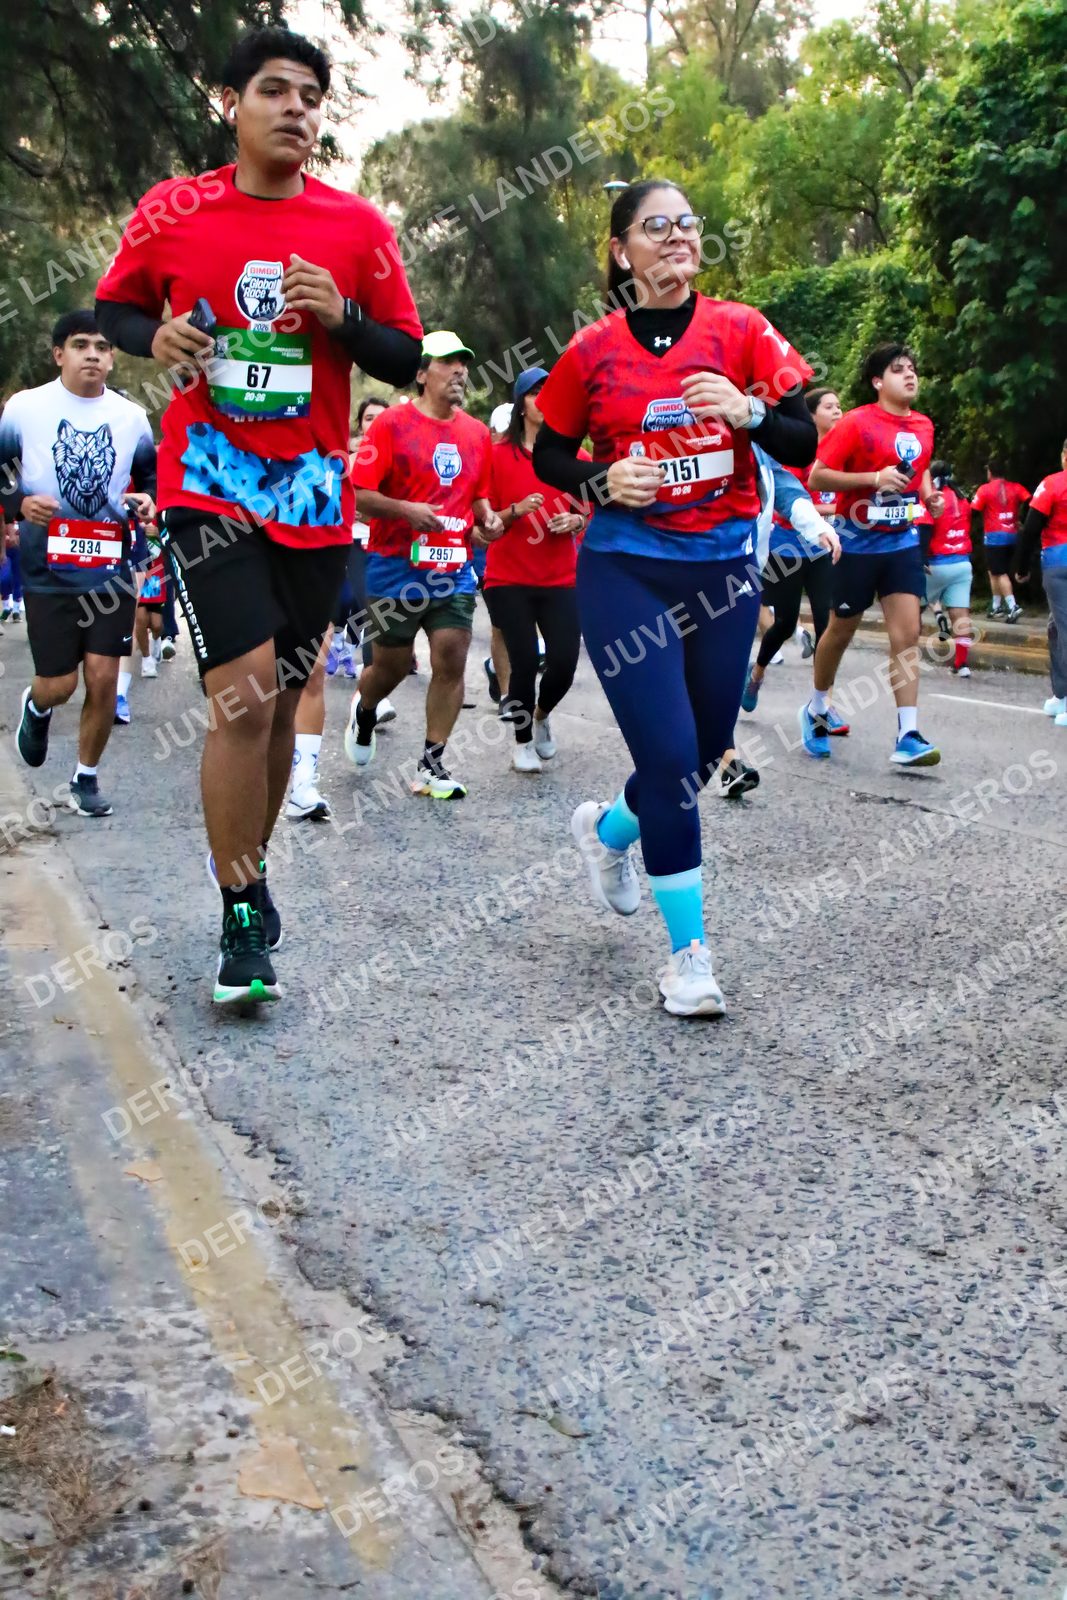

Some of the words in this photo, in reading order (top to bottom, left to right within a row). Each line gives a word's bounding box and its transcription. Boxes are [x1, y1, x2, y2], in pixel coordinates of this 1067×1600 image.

[250, 266, 277, 275] BIMBO
[249, 278, 277, 290] Global
[243, 288, 266, 298] Race
[246, 364, 272, 388] 67
[653, 403, 683, 413] BIMBO
[655, 413, 684, 425] Global
[884, 507, 906, 518] 4133
[70, 539, 102, 555] 2934
[429, 548, 454, 561] 2957
